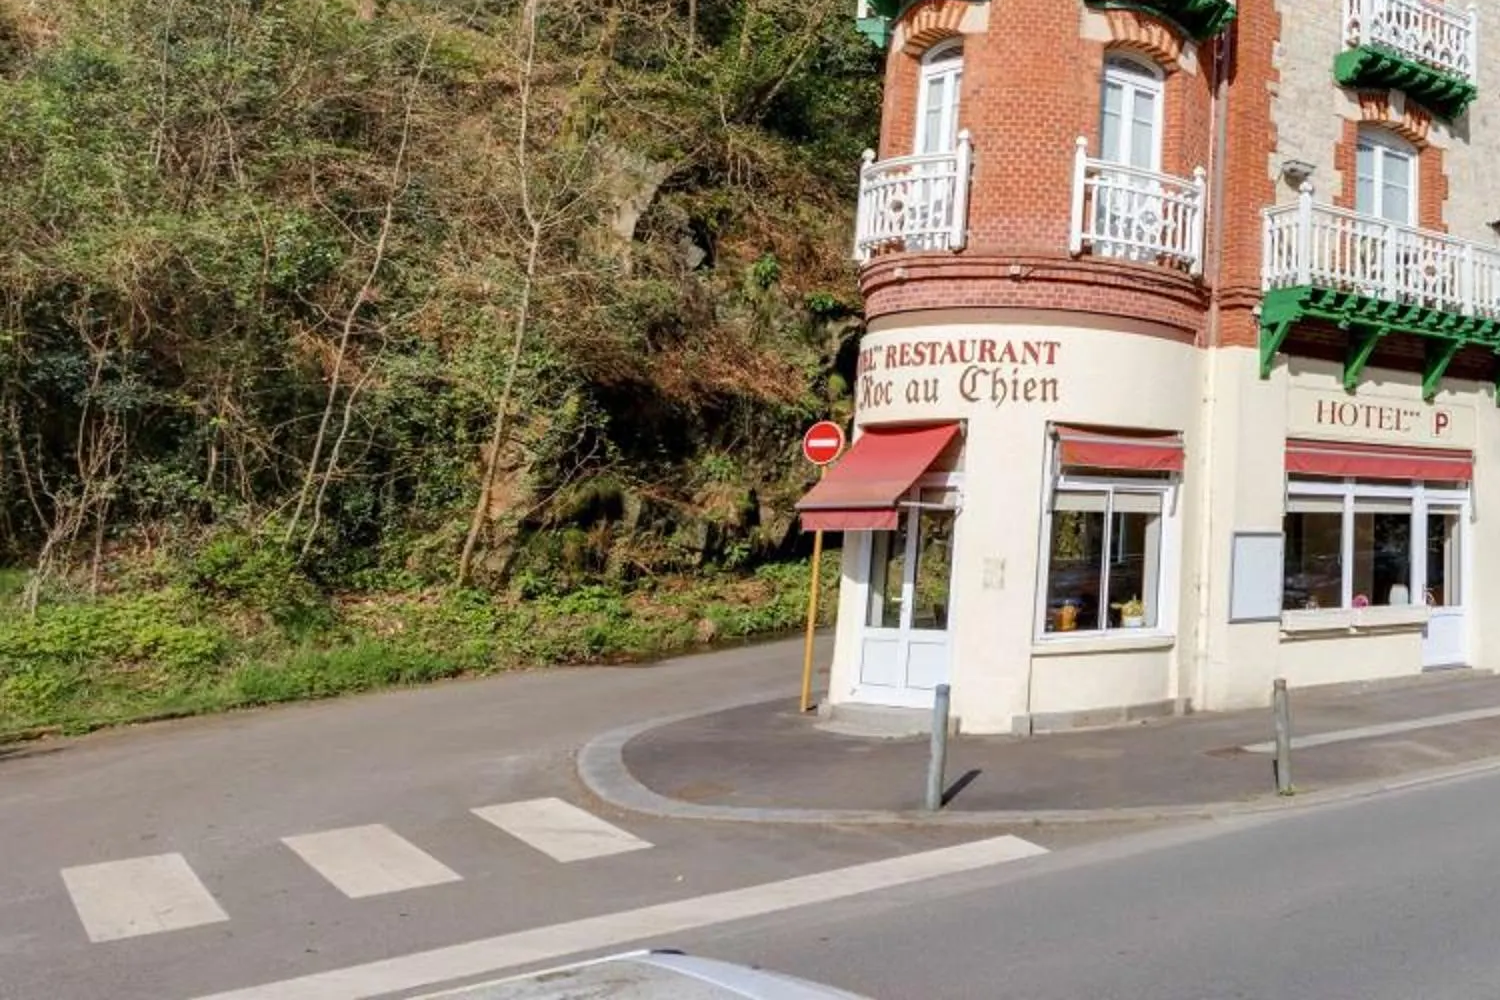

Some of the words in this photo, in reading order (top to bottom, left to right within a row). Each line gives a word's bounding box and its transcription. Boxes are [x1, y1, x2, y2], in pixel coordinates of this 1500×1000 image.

[885, 339, 1061, 369] RESTAURANT
[905, 378, 939, 404] au
[959, 365, 1060, 408] Chien
[1316, 399, 1411, 432] HOTEL
[1434, 411, 1449, 435] P
